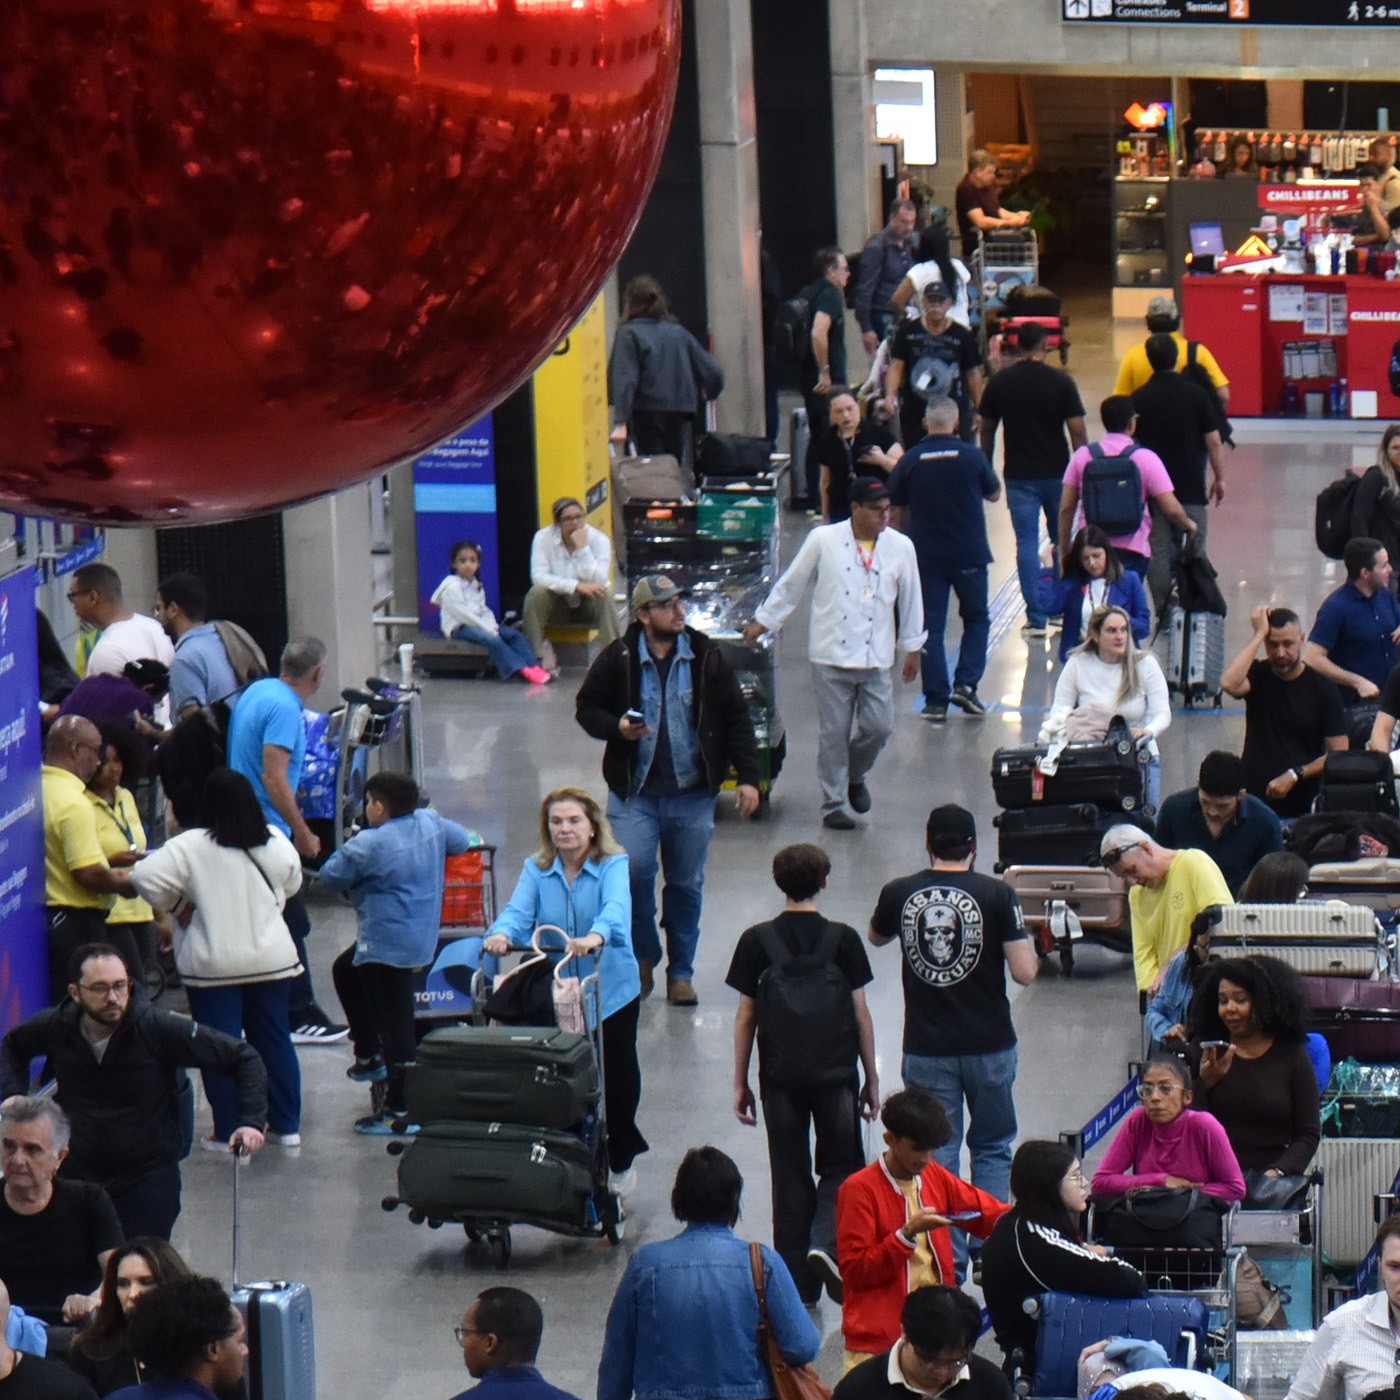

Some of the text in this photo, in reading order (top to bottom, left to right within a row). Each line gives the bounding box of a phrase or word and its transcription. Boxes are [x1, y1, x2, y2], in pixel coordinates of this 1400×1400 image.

[1115, 6, 1182, 18] Connections
[1186, 1, 1227, 13] Terminal
[1366, 6, 1387, 18] 2-6
[1266, 190, 1349, 201] CHILLIBEANS
[904, 889, 980, 926] INSANOS
[964, 929, 981, 939] MC
[908, 945, 978, 983] URUGUAY
